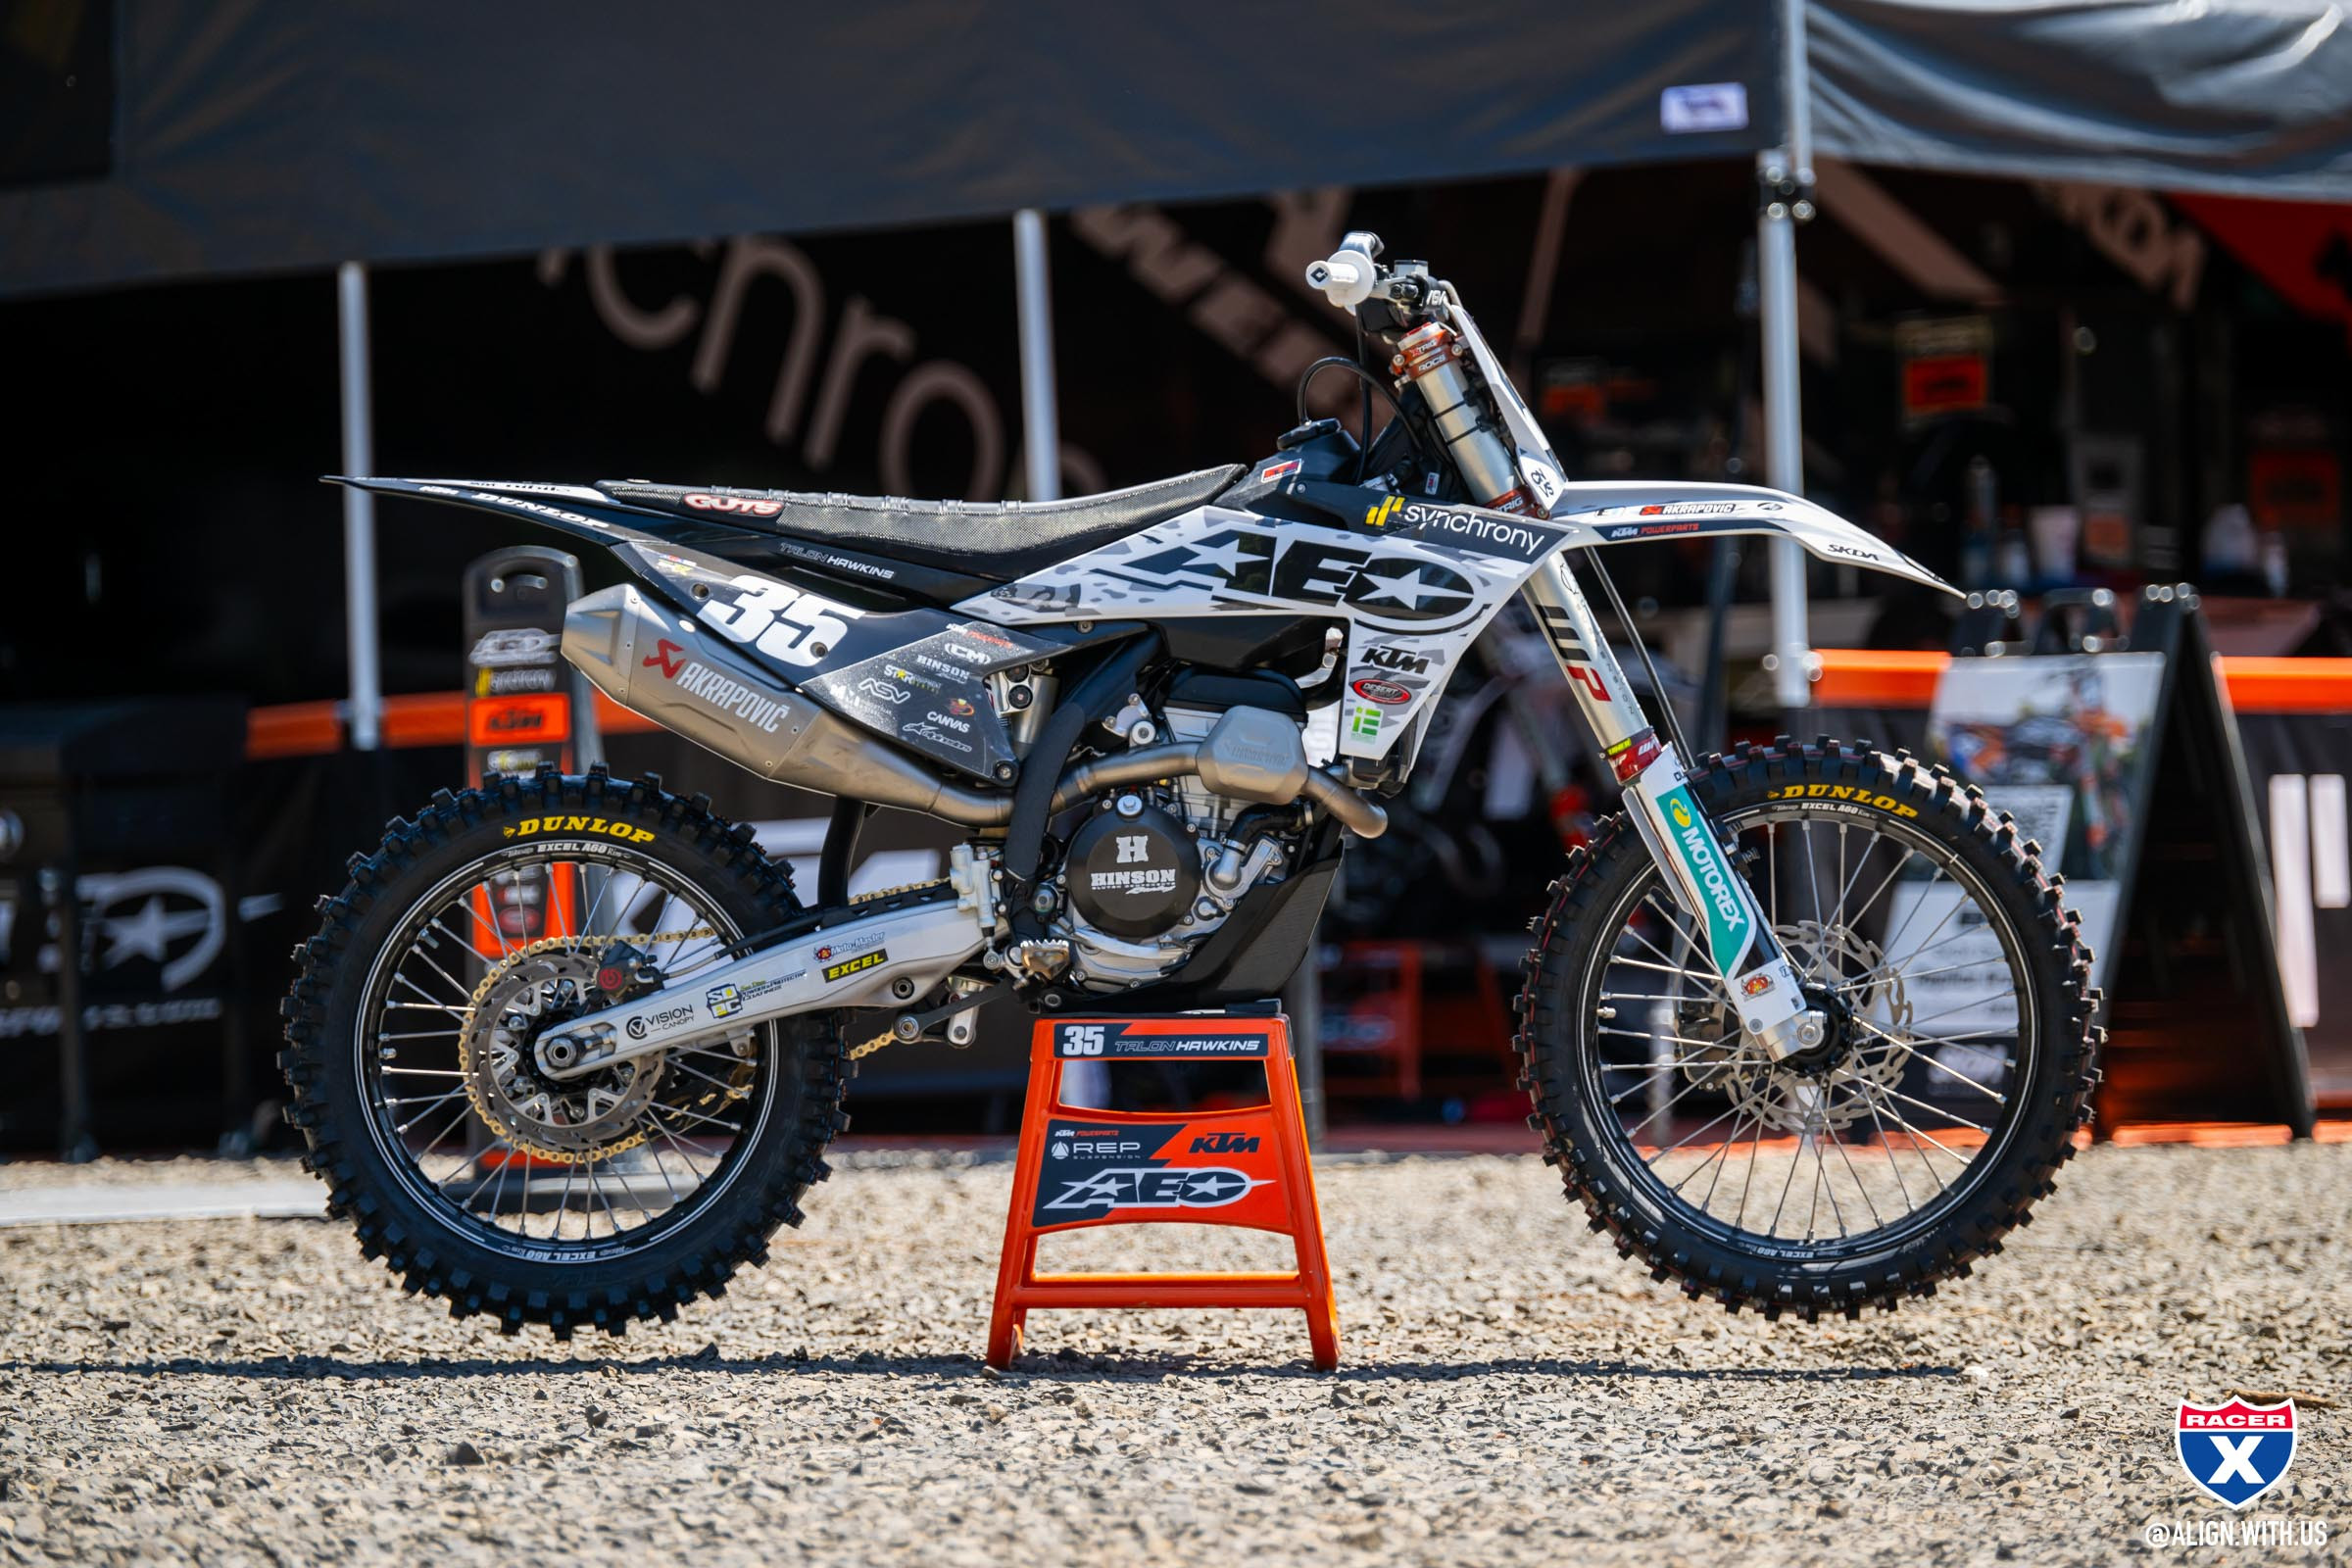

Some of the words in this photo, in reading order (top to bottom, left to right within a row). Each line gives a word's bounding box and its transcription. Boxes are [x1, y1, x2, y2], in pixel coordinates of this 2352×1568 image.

[471, 492, 610, 528] DUNLOP
[684, 493, 784, 516] GUTS
[1494, 496, 1524, 514] TRIG
[1403, 503, 1545, 556] synchrony
[780, 542, 829, 563] TALON
[827, 555, 895, 579] HAWKINS
[1102, 528, 1477, 623] AEO
[697, 574, 866, 667] 35
[1360, 645, 1431, 675] KTM
[1535, 603, 1613, 703] WP
[916, 655, 971, 680] HINSON
[676, 662, 791, 734] AKRAPOVIČ
[927, 710, 970, 733] CANVAS
[1781, 784, 1919, 819] DUNLOP
[1801, 802, 1837, 812] EXCEL
[1837, 804, 1860, 815] A60
[516, 815, 656, 844] DUNLOP
[537, 842, 580, 854] EXCEL
[581, 842, 609, 855] A60
[1115, 835, 1150, 863] H
[1091, 868, 1176, 888] HINSON
[1681, 826, 1746, 932] MOTOREX
[828, 955, 886, 980] EXCEL
[646, 1004, 694, 1026] VISION
[662, 1015, 695, 1030] CANOPY
[1062, 1026, 1105, 1056] 35
[1114, 1041, 1176, 1052] TALON
[1175, 1040, 1261, 1052] HAWKINS
[1073, 1142, 1142, 1154] REP
[1189, 1132, 1261, 1154] KTM
[1043, 1166, 1256, 1209] AEO
